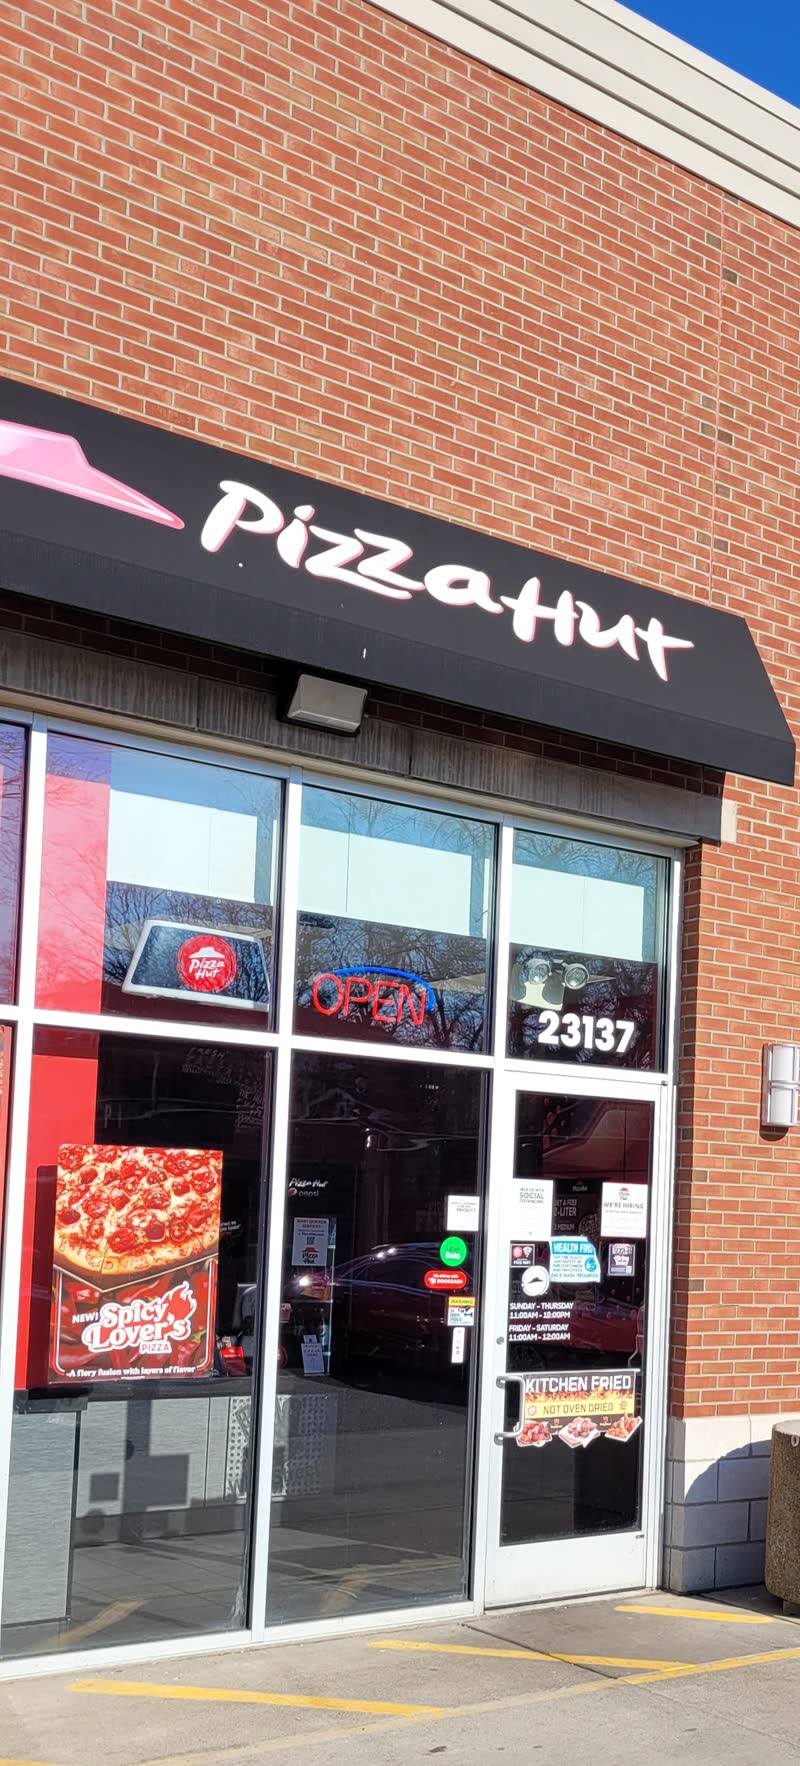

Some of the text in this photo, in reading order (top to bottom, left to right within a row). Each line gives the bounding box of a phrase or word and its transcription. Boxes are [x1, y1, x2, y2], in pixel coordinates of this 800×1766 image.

[200, 479, 694, 682] Pizza Hut
[189, 958, 225, 973] Pizza
[195, 969, 220, 980] Hut
[313, 973, 427, 1025] OPEN
[538, 1010, 635, 1053] 23137
[289, 1178, 328, 1188] Pizza Hut
[520, 1192, 544, 1200] SOCIAL
[554, 1207, 577, 1217] 2-LITER
[554, 1243, 579, 1253] HEALTH
[509, 1302, 536, 1310] SUNDAY
[541, 1302, 574, 1310] THURSDAY
[72, 1311, 99, 1323] NEW!
[102, 1302, 169, 1328] Spicy
[543, 1311, 571, 1319] 10:00PM
[86, 1313, 187, 1348] Lover's
[508, 1324, 531, 1332] FRIDAY
[536, 1324, 569, 1332] SATURDAY
[508, 1333, 538, 1341] 11:00AM
[141, 1342, 169, 1353] PIZZA
[79, 1367, 97, 1378] fiery
[98, 1367, 122, 1376] fusion
[124, 1366, 140, 1375] with
[141, 1365, 163, 1377] layers
[164, 1365, 173, 1374] of
[172, 1365, 195, 1374] flavor
[526, 1375, 631, 1392] KITCHEN FRIED
[543, 1402, 614, 1415] NOT OVEN DRIED
